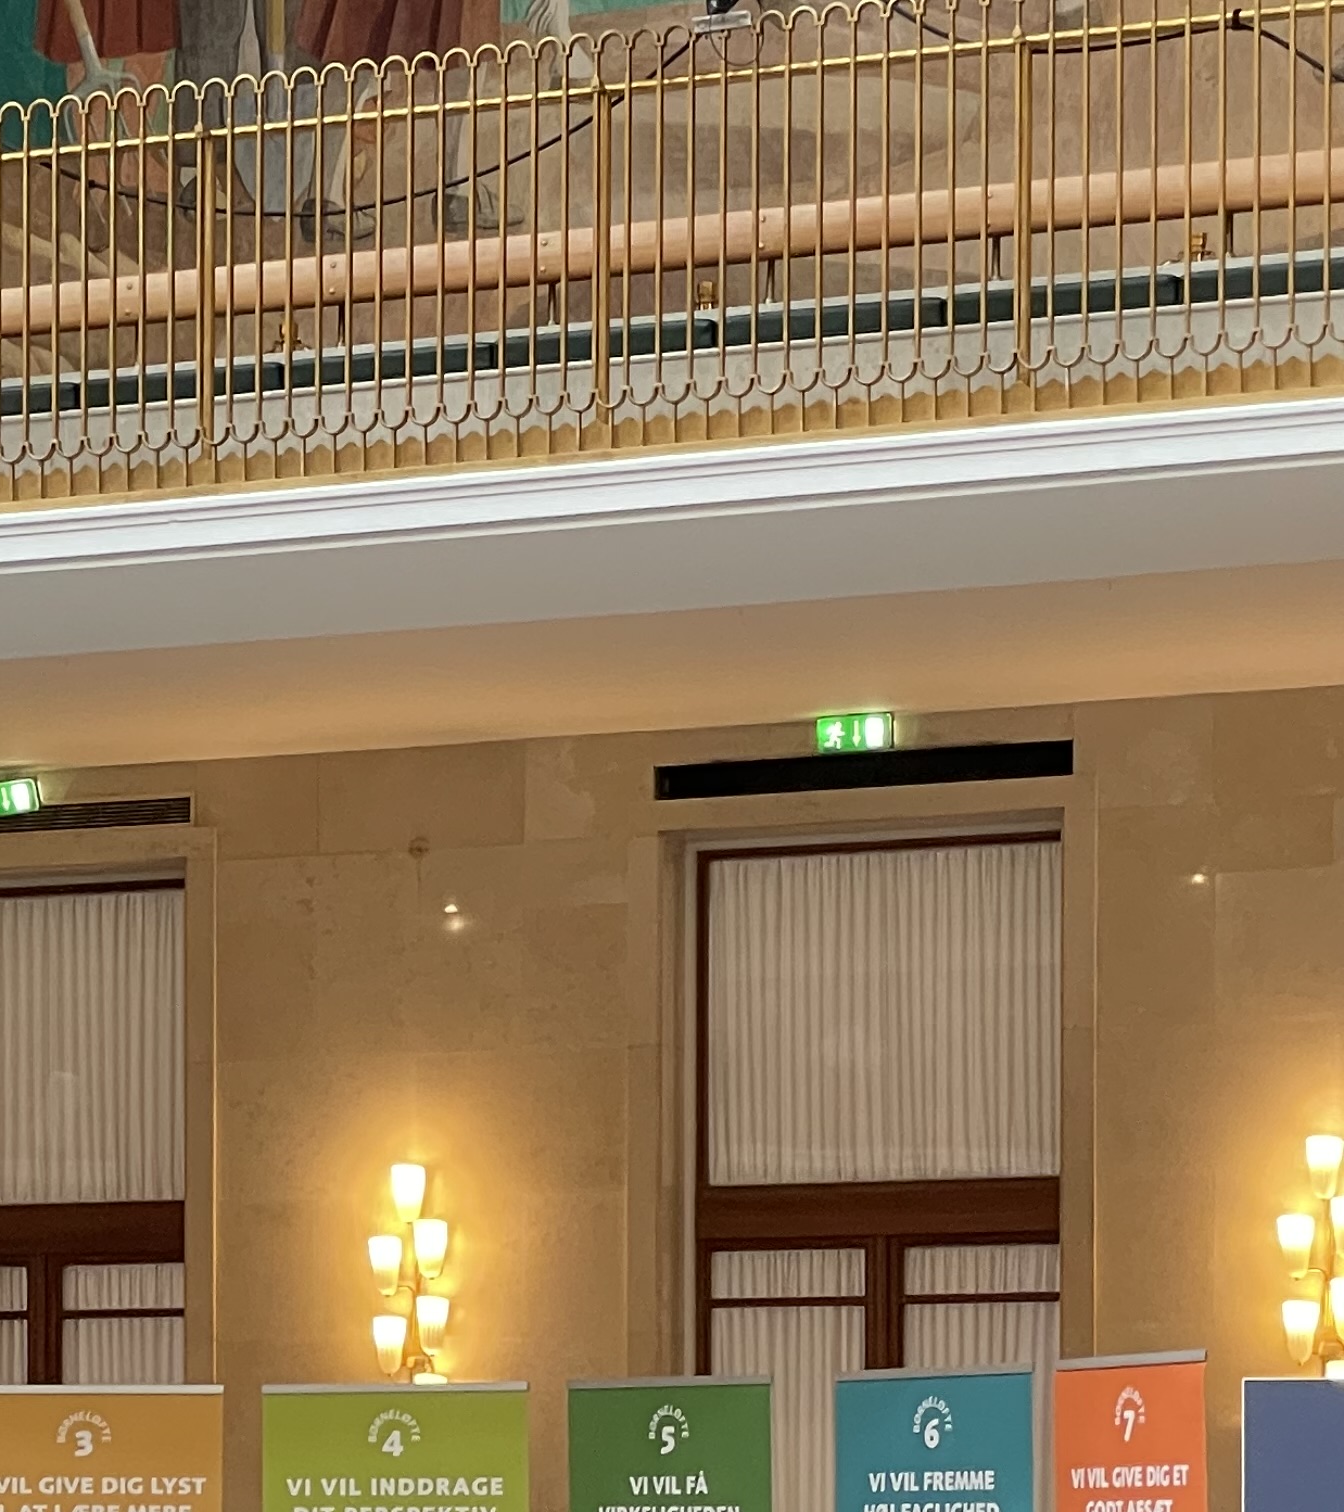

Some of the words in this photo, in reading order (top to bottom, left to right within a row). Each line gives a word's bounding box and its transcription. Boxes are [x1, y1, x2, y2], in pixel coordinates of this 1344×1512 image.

[924, 1418, 940, 1449] 6
[1123, 1410, 1136, 1442] 7
[74, 1430, 93, 1457] 3
[381, 1430, 404, 1457] 4
[660, 1425, 676, 1455] 5
[38, 1476, 94, 1495] GIVE
[101, 1476, 143, 1495] DIG
[151, 1476, 207, 1495] LYST
[286, 1478, 311, 1496] VI
[320, 1478, 361, 1496] VIL
[370, 1477, 504, 1496] INDDRAGE
[629, 1476, 648, 1495] VI
[652, 1476, 681, 1495] VIL
[686, 1470, 708, 1495] FÅ
[868, 1472, 886, 1492] VI
[889, 1471, 919, 1492] VIL
[923, 1470, 995, 1491] FREMME
[1071, 1468, 1085, 1489] VI
[1087, 1467, 1109, 1488] VIL
[1112, 1466, 1143, 1488] GIVE
[1146, 1465, 1170, 1487] DIG
[1173, 1464, 1189, 1486] ET
